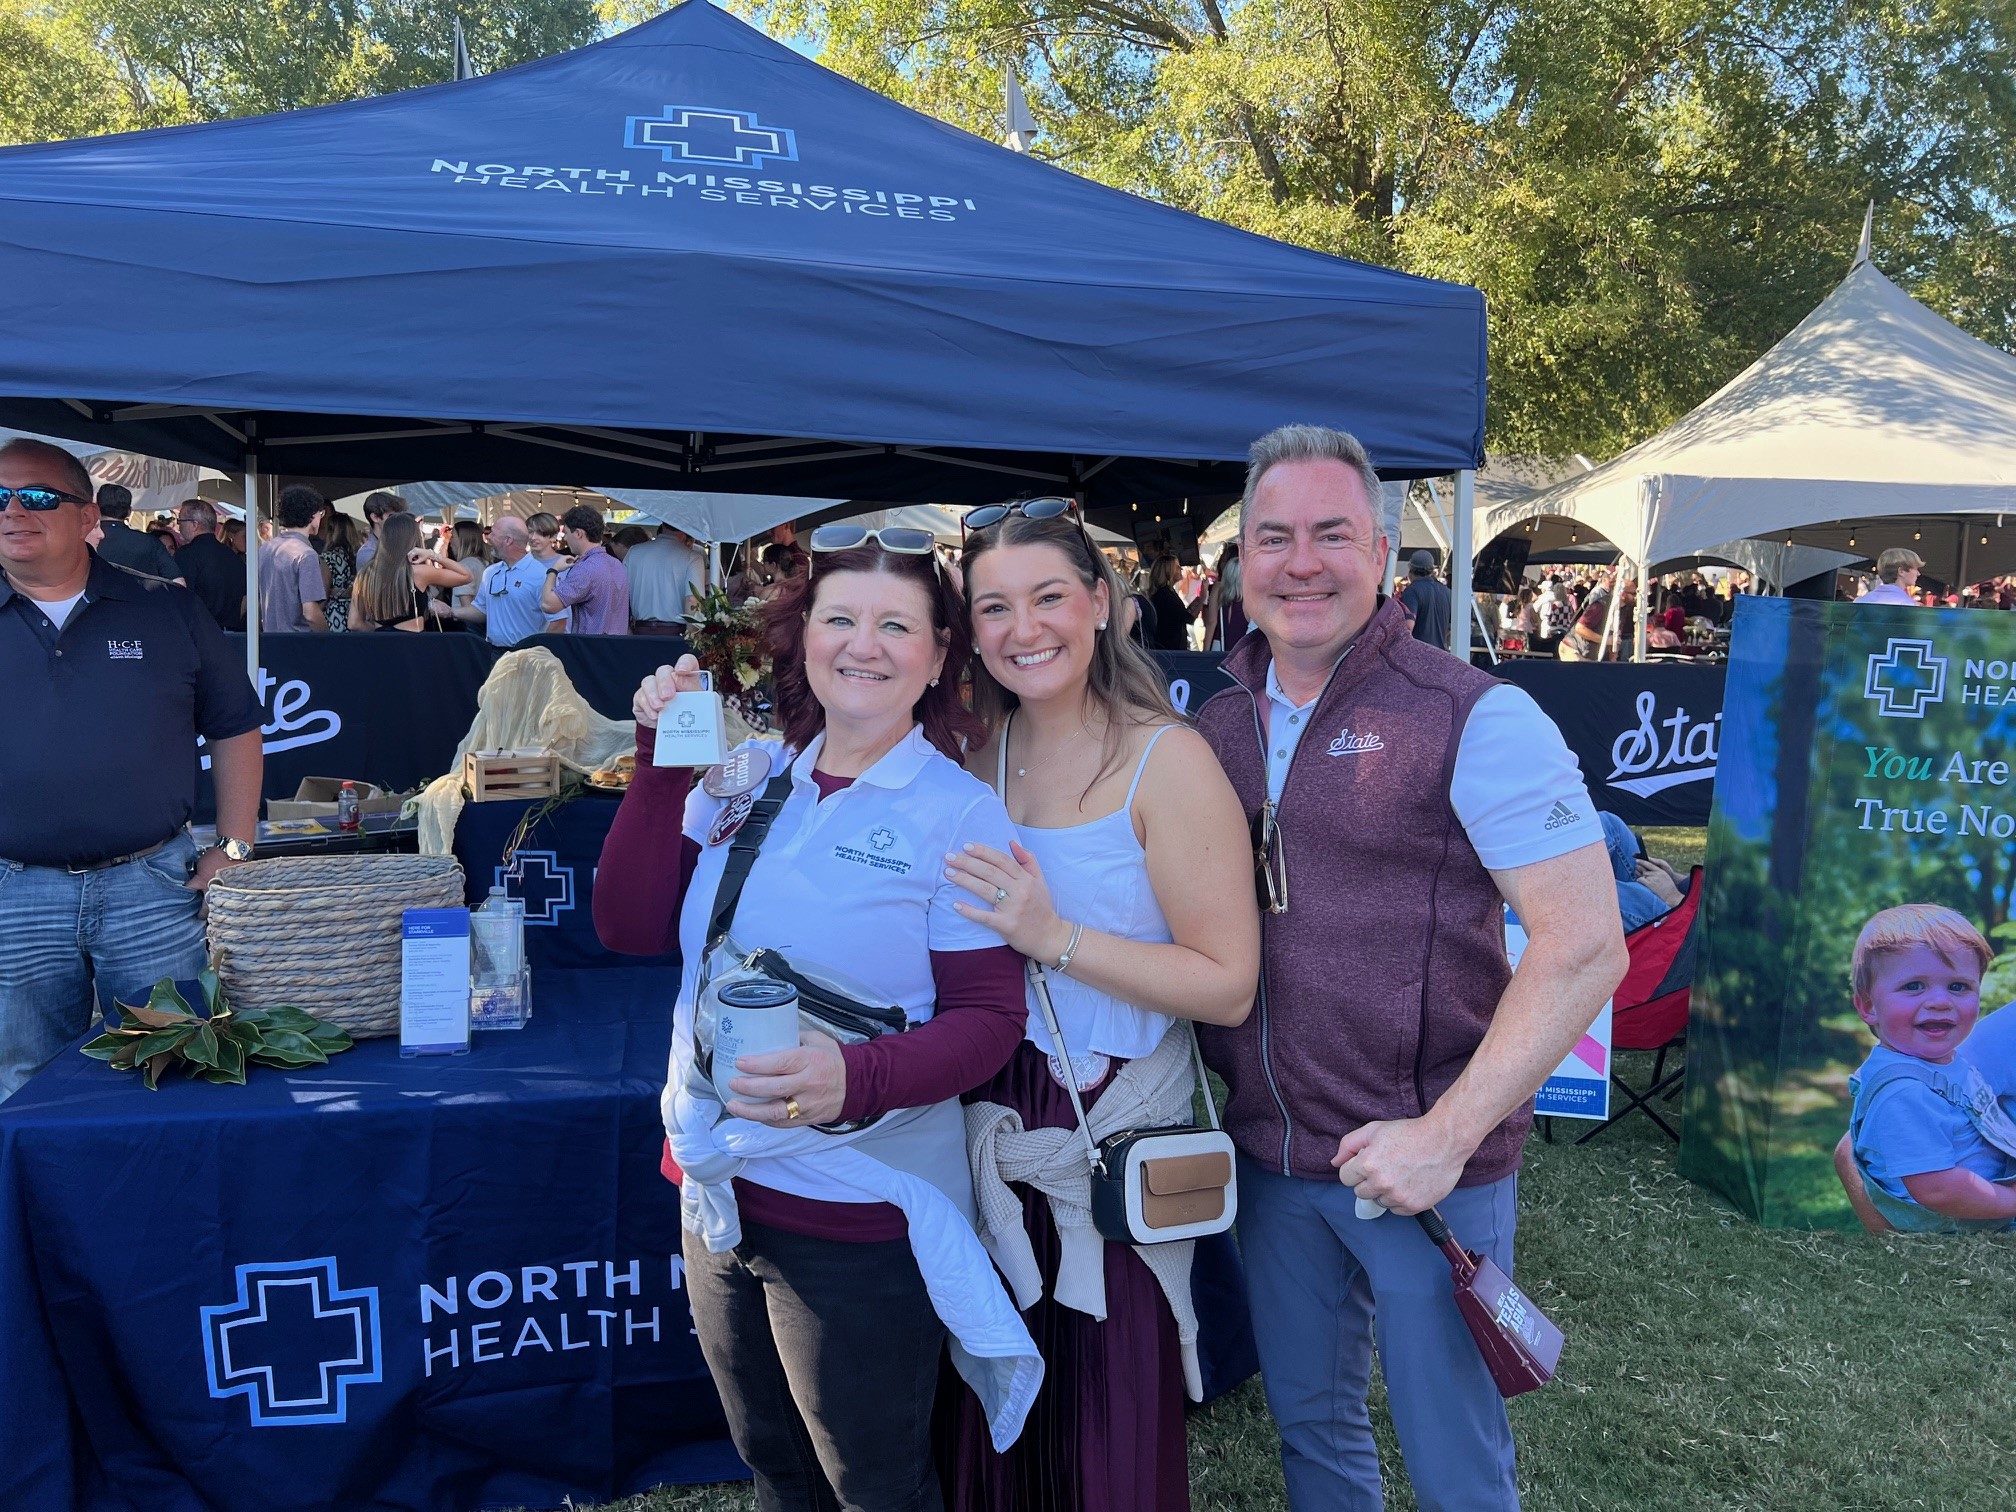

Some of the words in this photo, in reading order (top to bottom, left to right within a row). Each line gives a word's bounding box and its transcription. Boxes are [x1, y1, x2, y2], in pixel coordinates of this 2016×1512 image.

[430, 158, 631, 182] NORTH
[656, 170, 977, 211] MISSISSIPPI
[454, 174, 674, 198] HEALTH
[699, 188, 958, 222] SERVICES
[1964, 659, 2016, 680] NO
[1326, 728, 1384, 756] State
[1605, 691, 1722, 782] Sta
[737, 752, 750, 787] PROUD
[1863, 746, 1934, 781] You
[1938, 750, 2010, 785] Are
[1544, 813, 1581, 831] adidas
[1854, 798, 1948, 834] True
[1957, 804, 2016, 838] No
[834, 845, 865, 857] NORTH
[866, 853, 912, 870] MISSISSIPPI
[835, 851, 868, 865] HEALTH
[868, 860, 906, 875] SERVICES
[1545, 1086, 1596, 1097] MISSISSIPPI
[1547, 1093, 1588, 1103] SERVICES
[420, 1259, 641, 1323] NORTH
[1495, 1286, 1520, 1328] TEXAS
[423, 1306, 660, 1378] HEALTH
